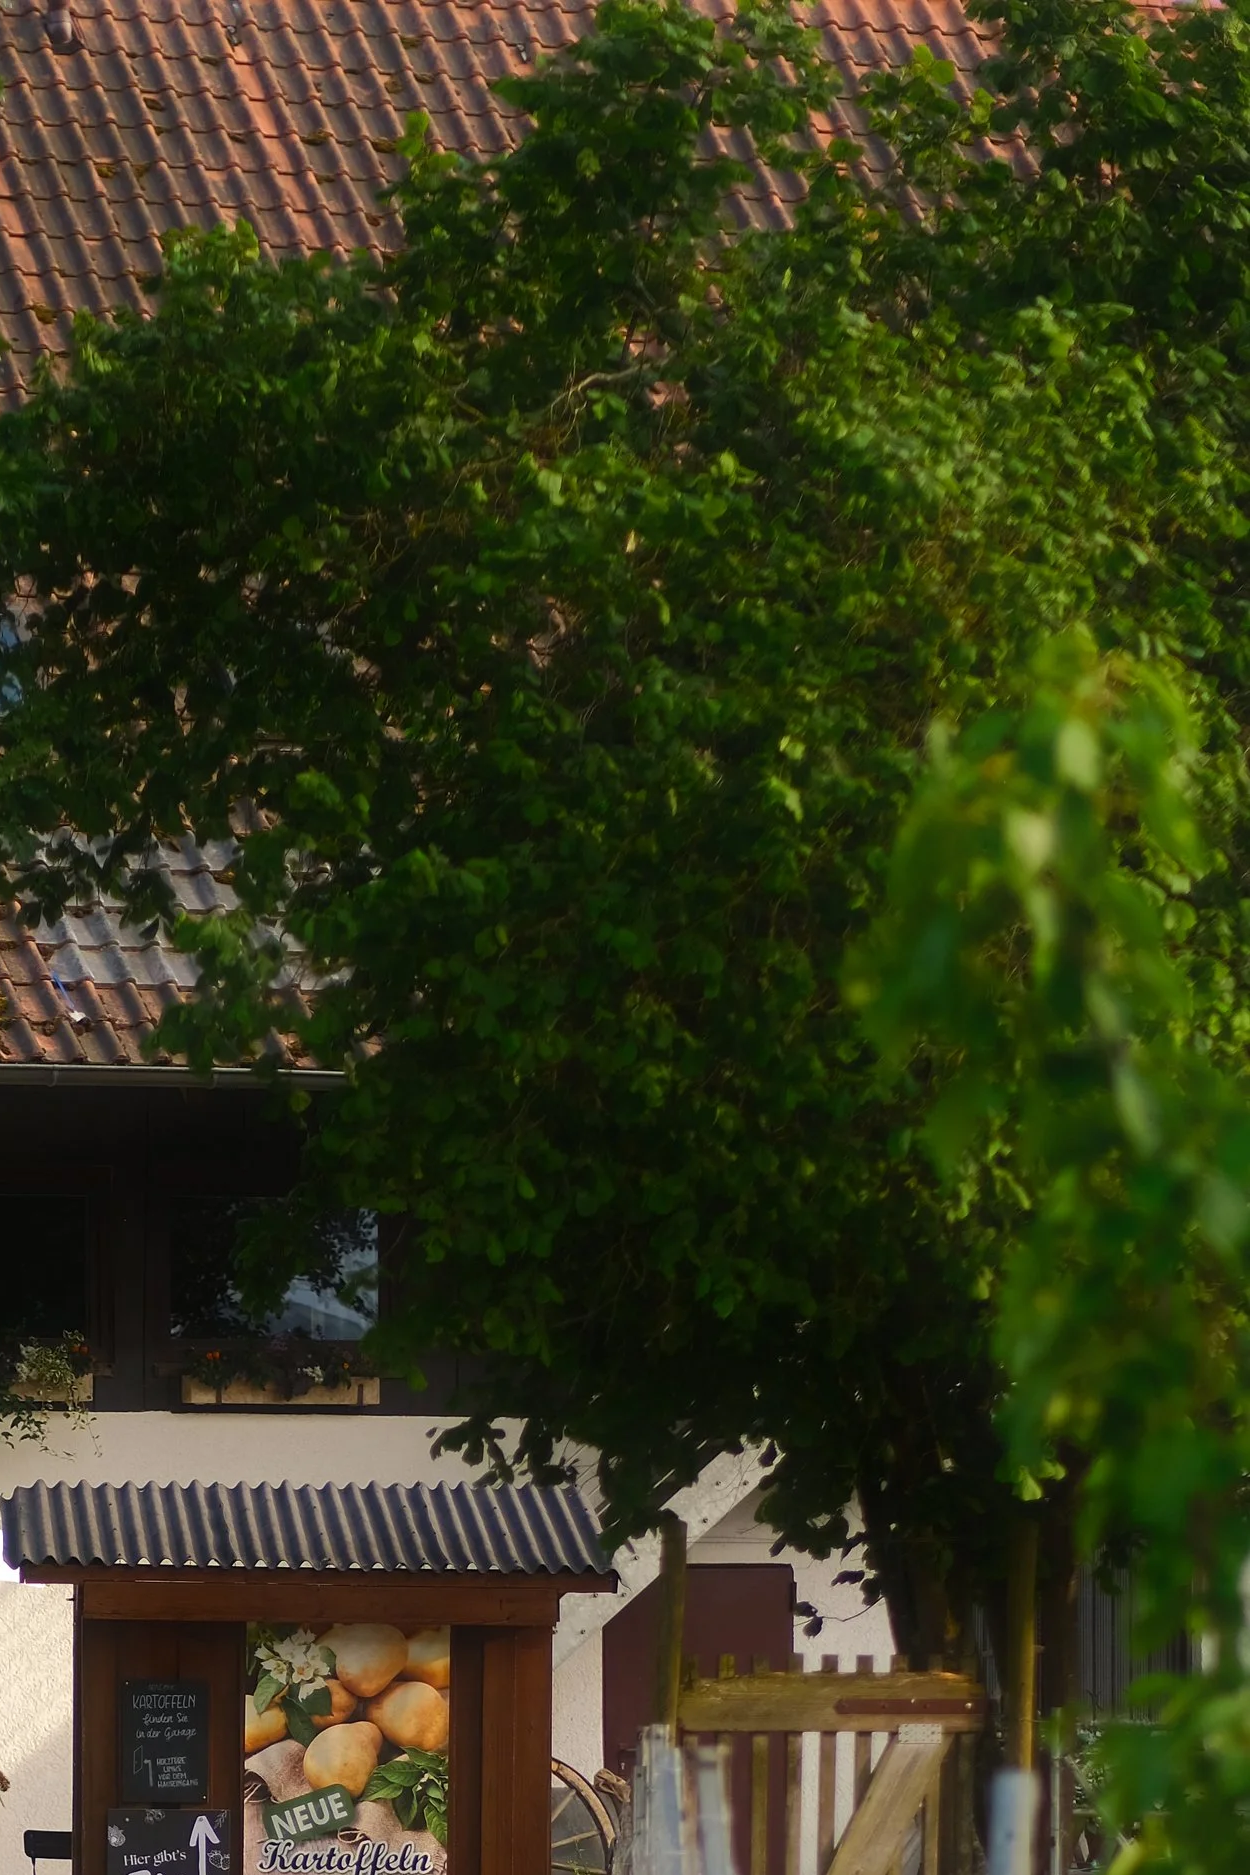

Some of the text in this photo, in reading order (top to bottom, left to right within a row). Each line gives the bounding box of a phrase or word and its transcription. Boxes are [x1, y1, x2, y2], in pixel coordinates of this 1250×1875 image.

[132, 1694, 196, 1709] KARTOFFELN
[146, 1728, 161, 1738] der
[164, 1727, 197, 1741] Garage
[271, 1792, 348, 1840] NEUE
[123, 1850, 187, 1867] Hier gibt's
